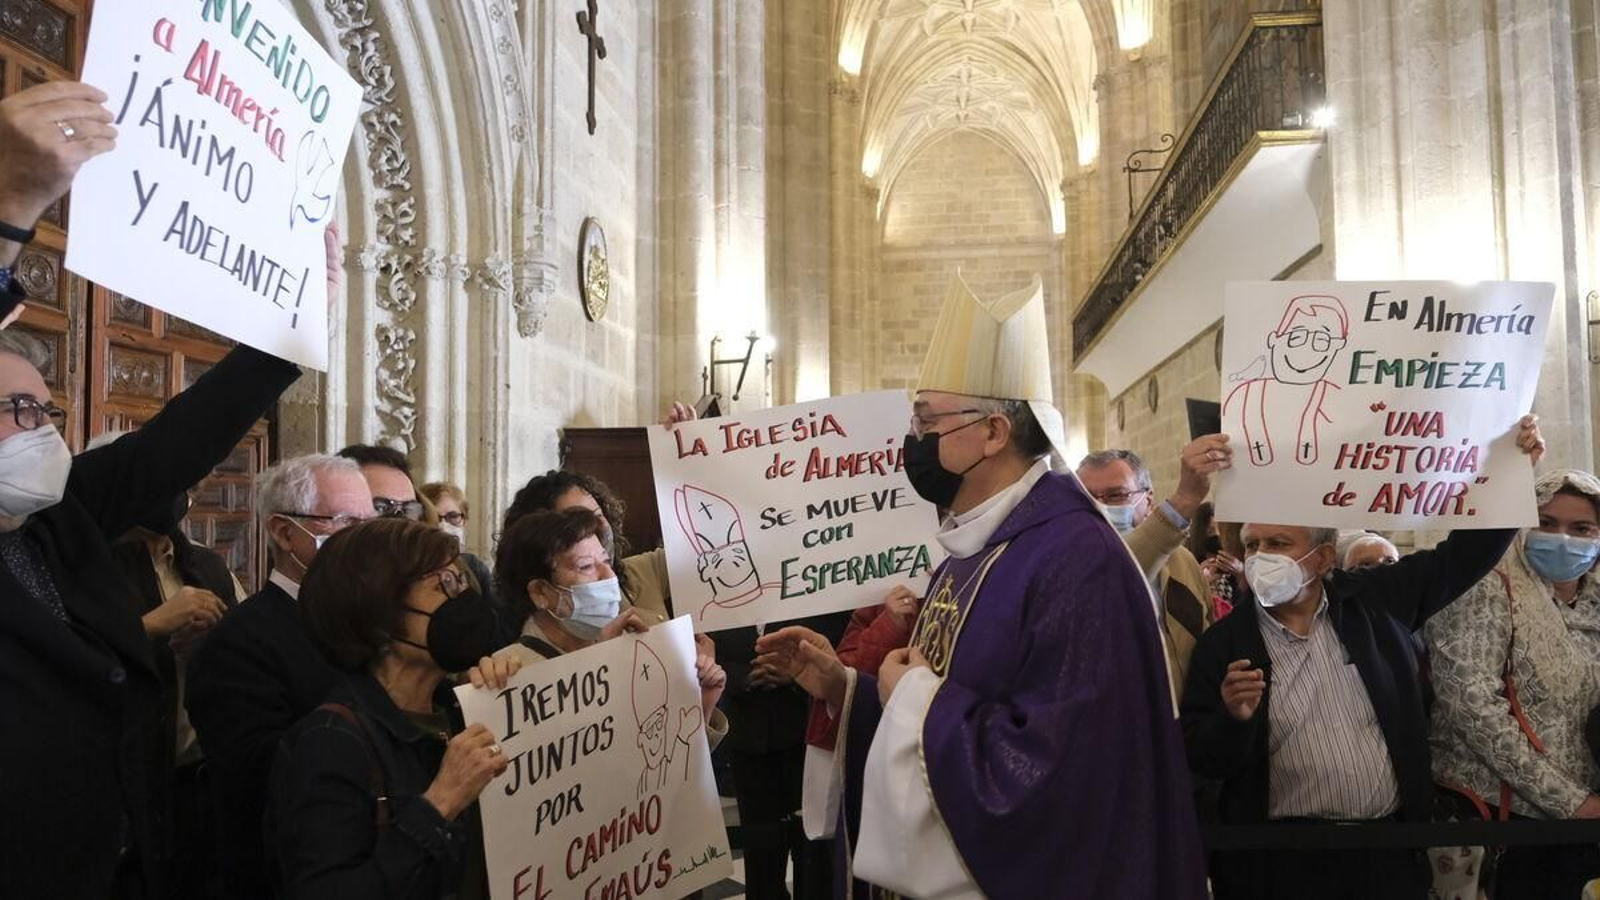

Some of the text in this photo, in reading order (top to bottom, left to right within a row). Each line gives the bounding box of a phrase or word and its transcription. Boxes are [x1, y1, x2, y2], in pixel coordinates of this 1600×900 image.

[153, 17, 287, 163] a Almería
[131, 170, 310, 329] Y ADELANTE!
[1413, 295, 1536, 335] Almería
[1348, 350, 1507, 391] EMPIEZA
[674, 412, 848, 460] LA IGLESIA
[765, 453, 797, 481] de
[760, 487, 916, 530] SE MUEVE
[1322, 481, 1357, 507] de
[802, 521, 854, 549] con
[780, 544, 933, 600] ESPERANZA
[497, 664, 610, 742] IREMOS
[504, 715, 615, 796] JUNTOS
[534, 783, 584, 836] POR
[565, 794, 662, 881] CAMINO
